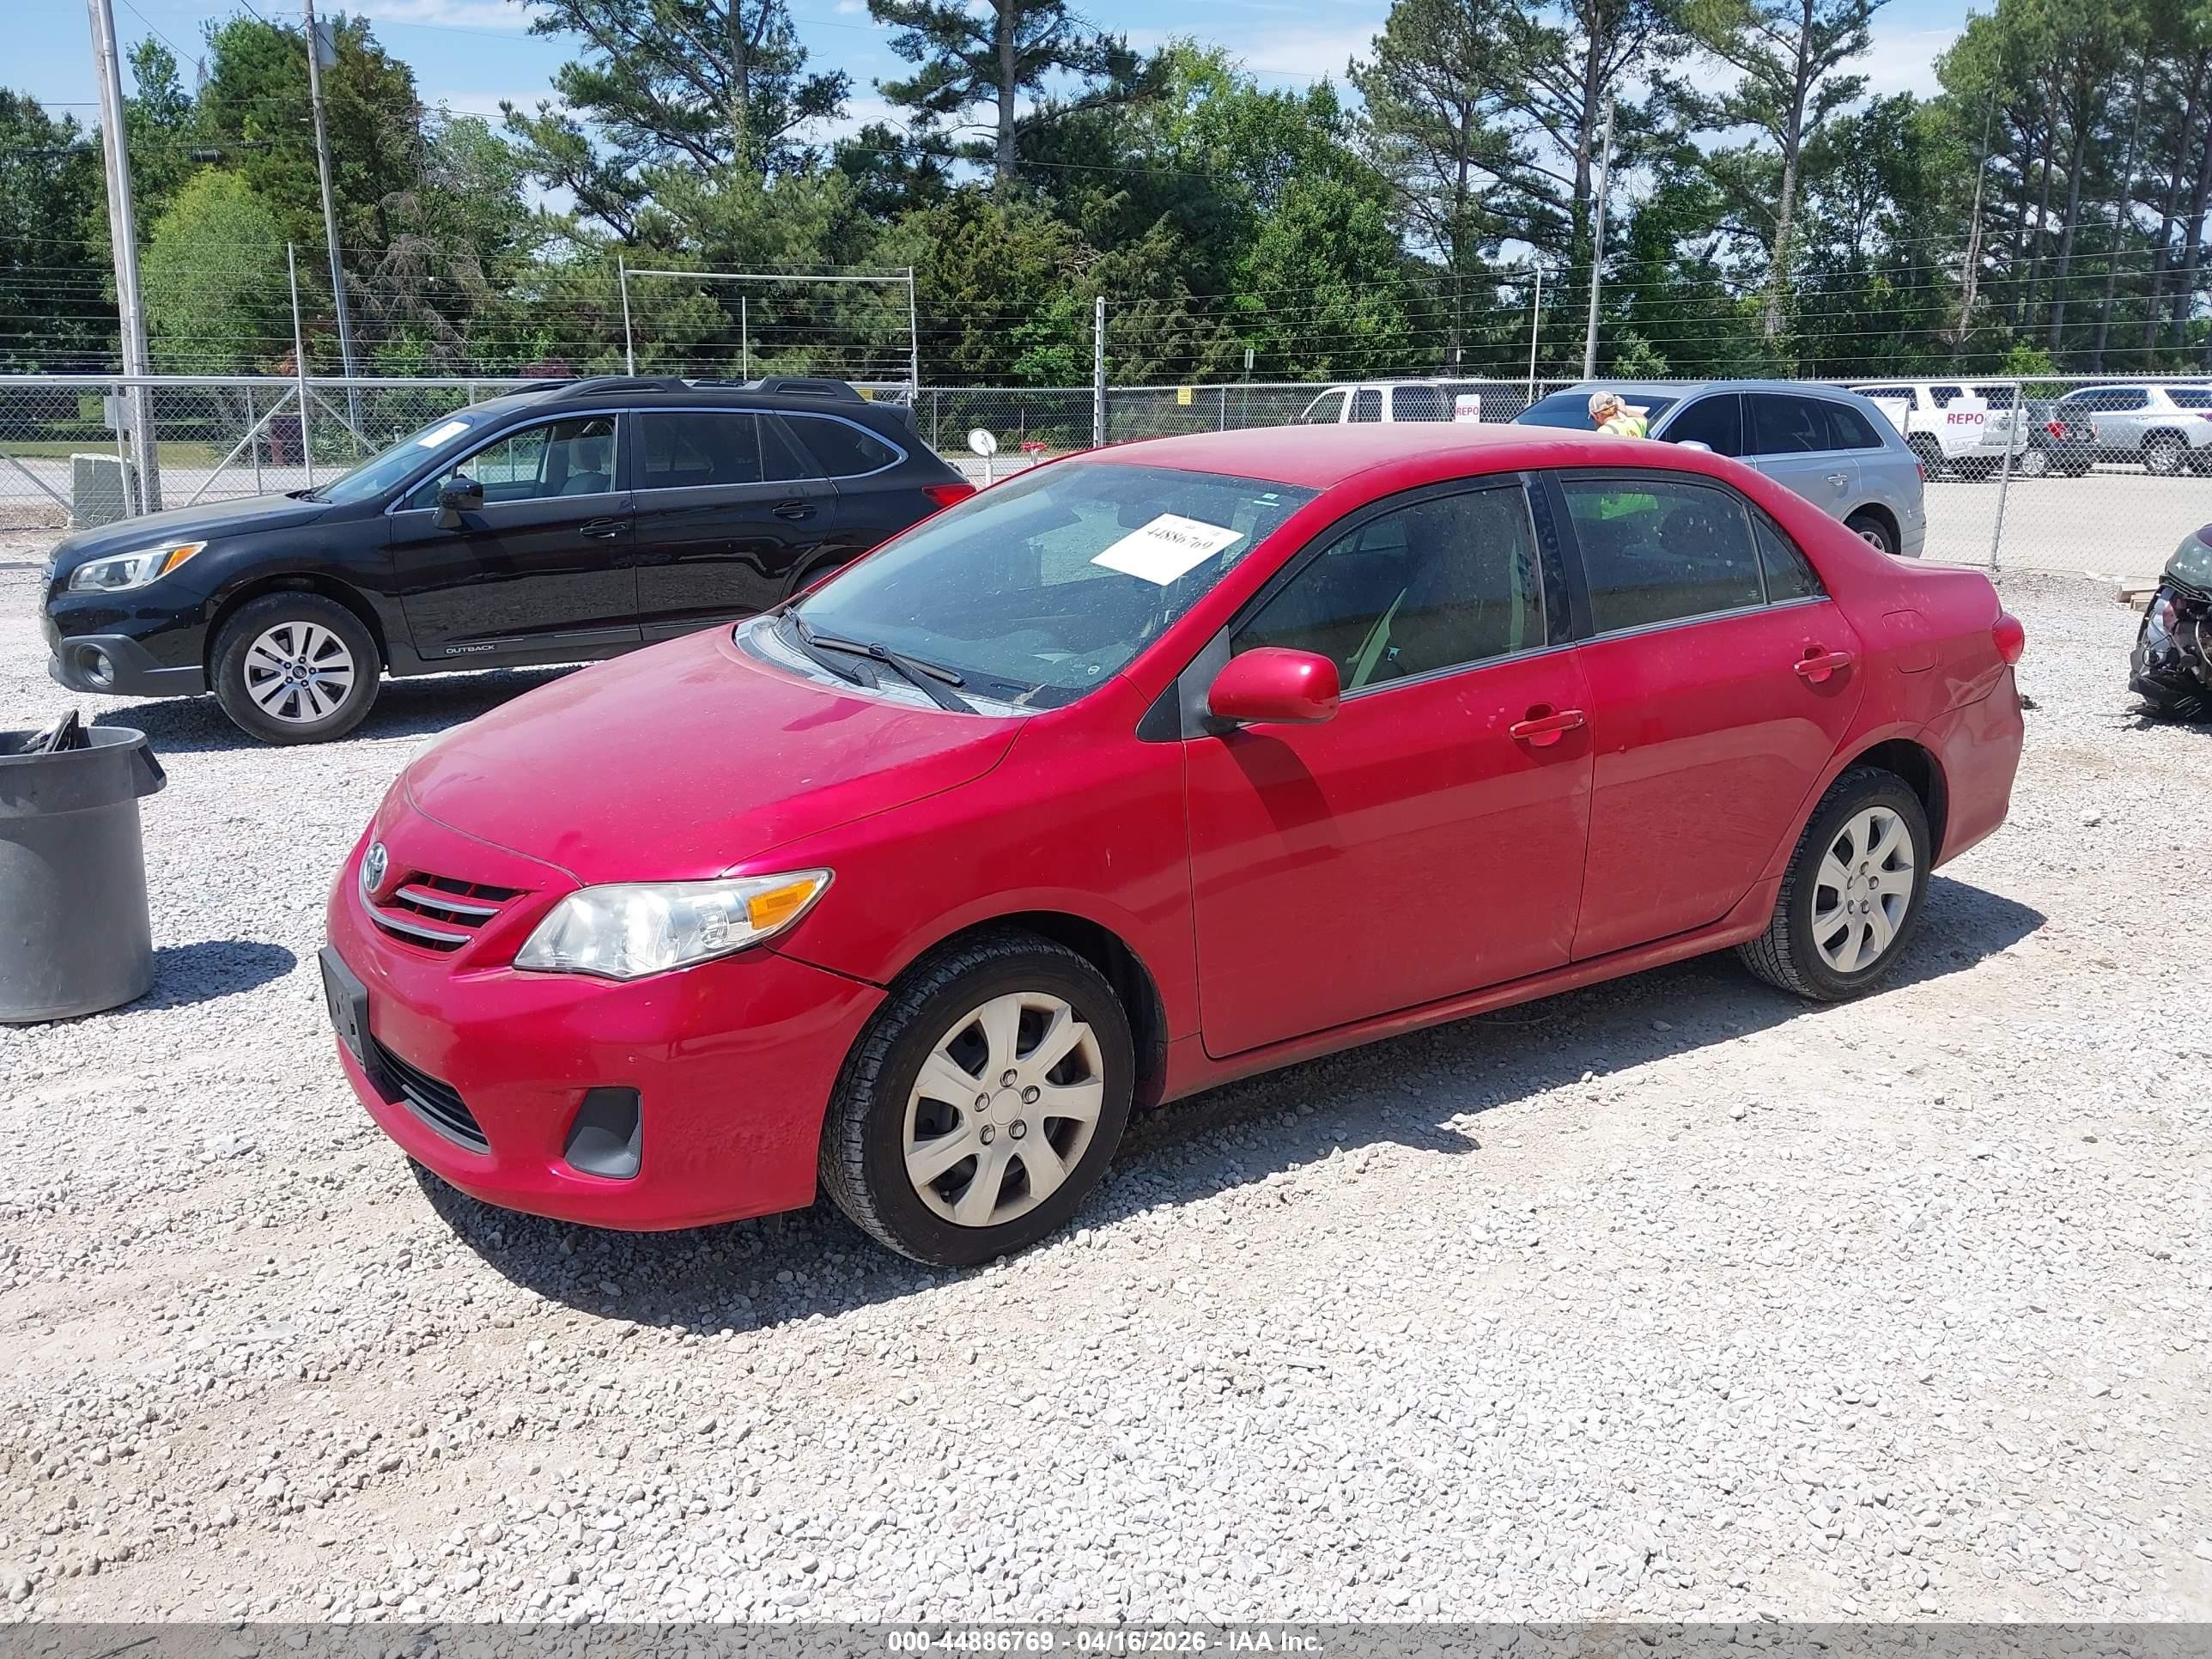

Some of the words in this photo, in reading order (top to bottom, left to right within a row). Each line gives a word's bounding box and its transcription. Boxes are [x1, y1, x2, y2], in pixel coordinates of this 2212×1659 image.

[1456, 406, 1479, 416] REPO
[1947, 413, 1984, 425] REPO
[446, 644, 495, 654] OUTBACK
